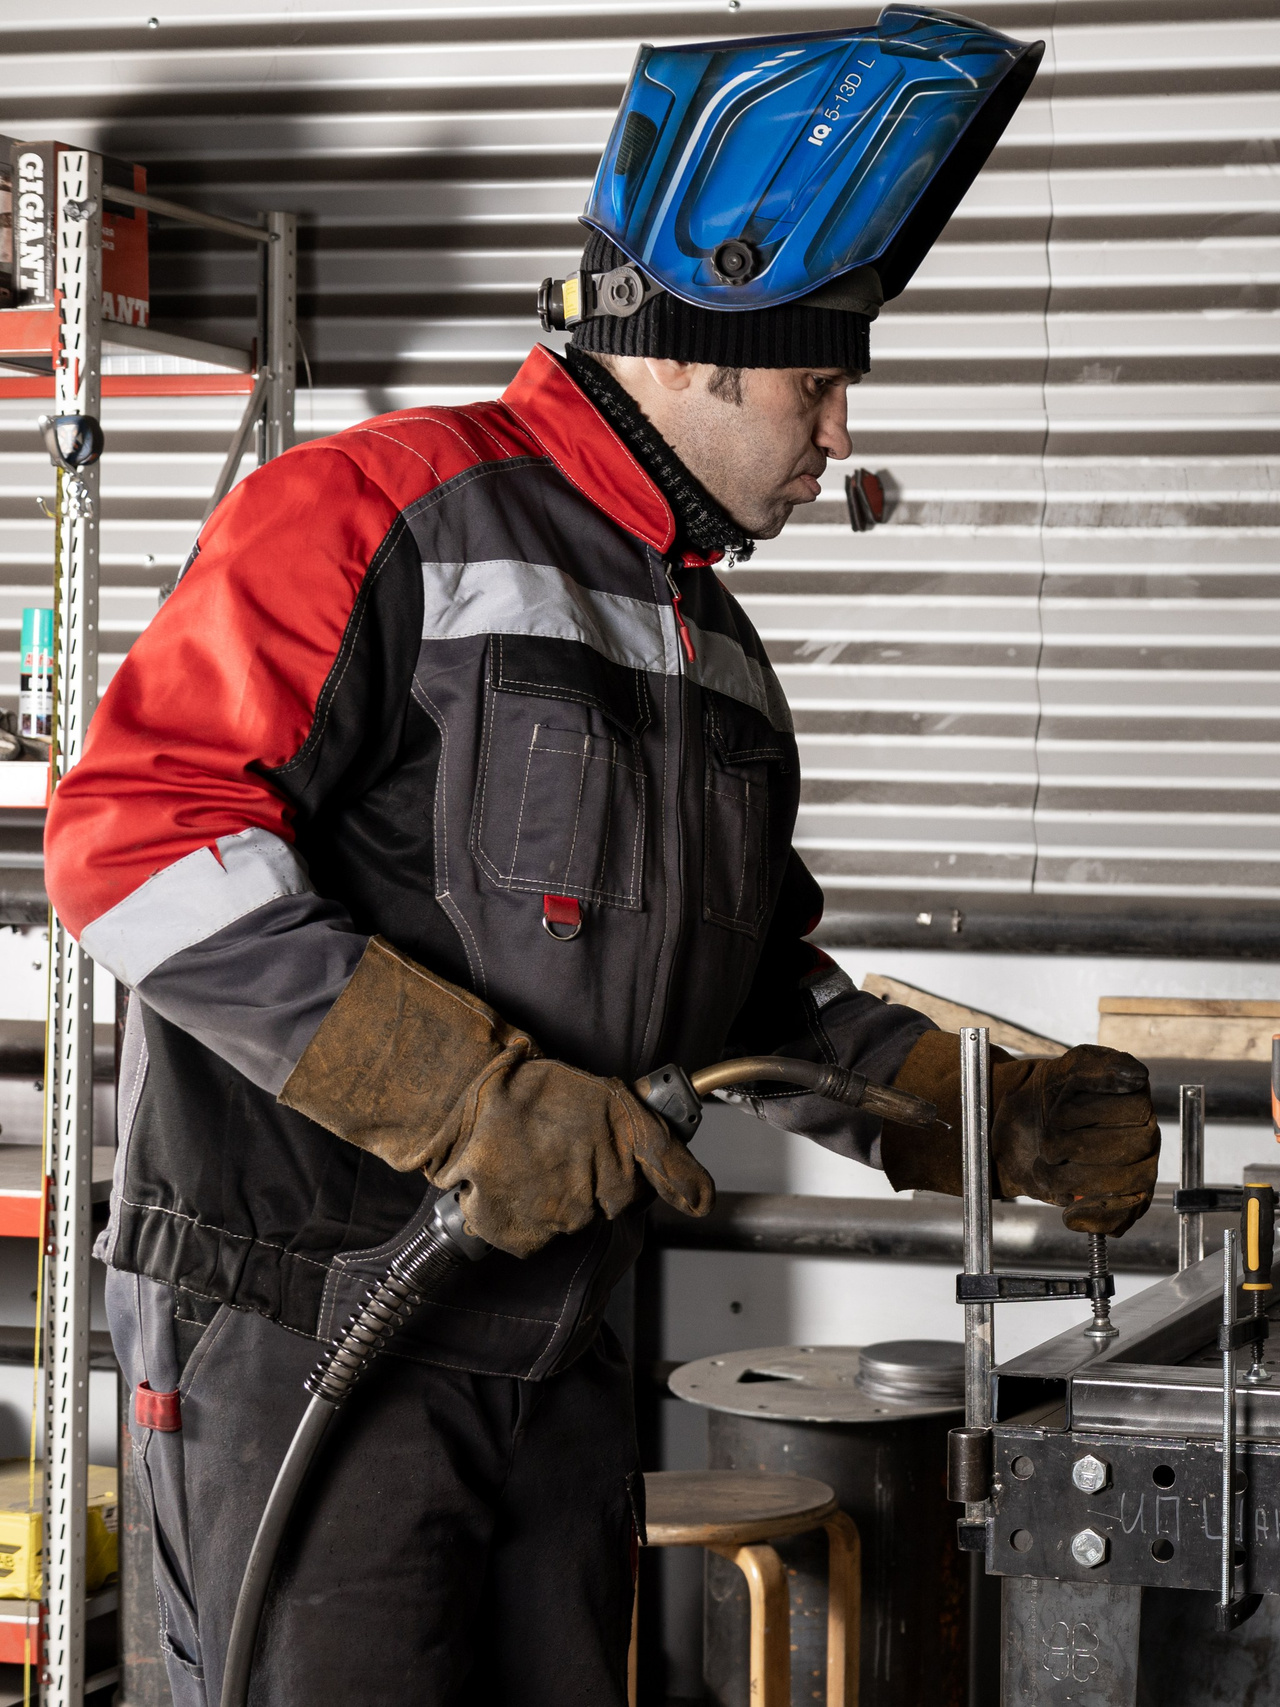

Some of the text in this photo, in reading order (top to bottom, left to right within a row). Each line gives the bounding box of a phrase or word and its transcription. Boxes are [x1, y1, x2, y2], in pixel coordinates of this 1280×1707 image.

[807, 59, 876, 147] IQ 5-13D L
[18, 152, 46, 297] GIGANT
[102, 291, 149, 328] ANT
[1120, 1492, 1180, 1541] ИП
